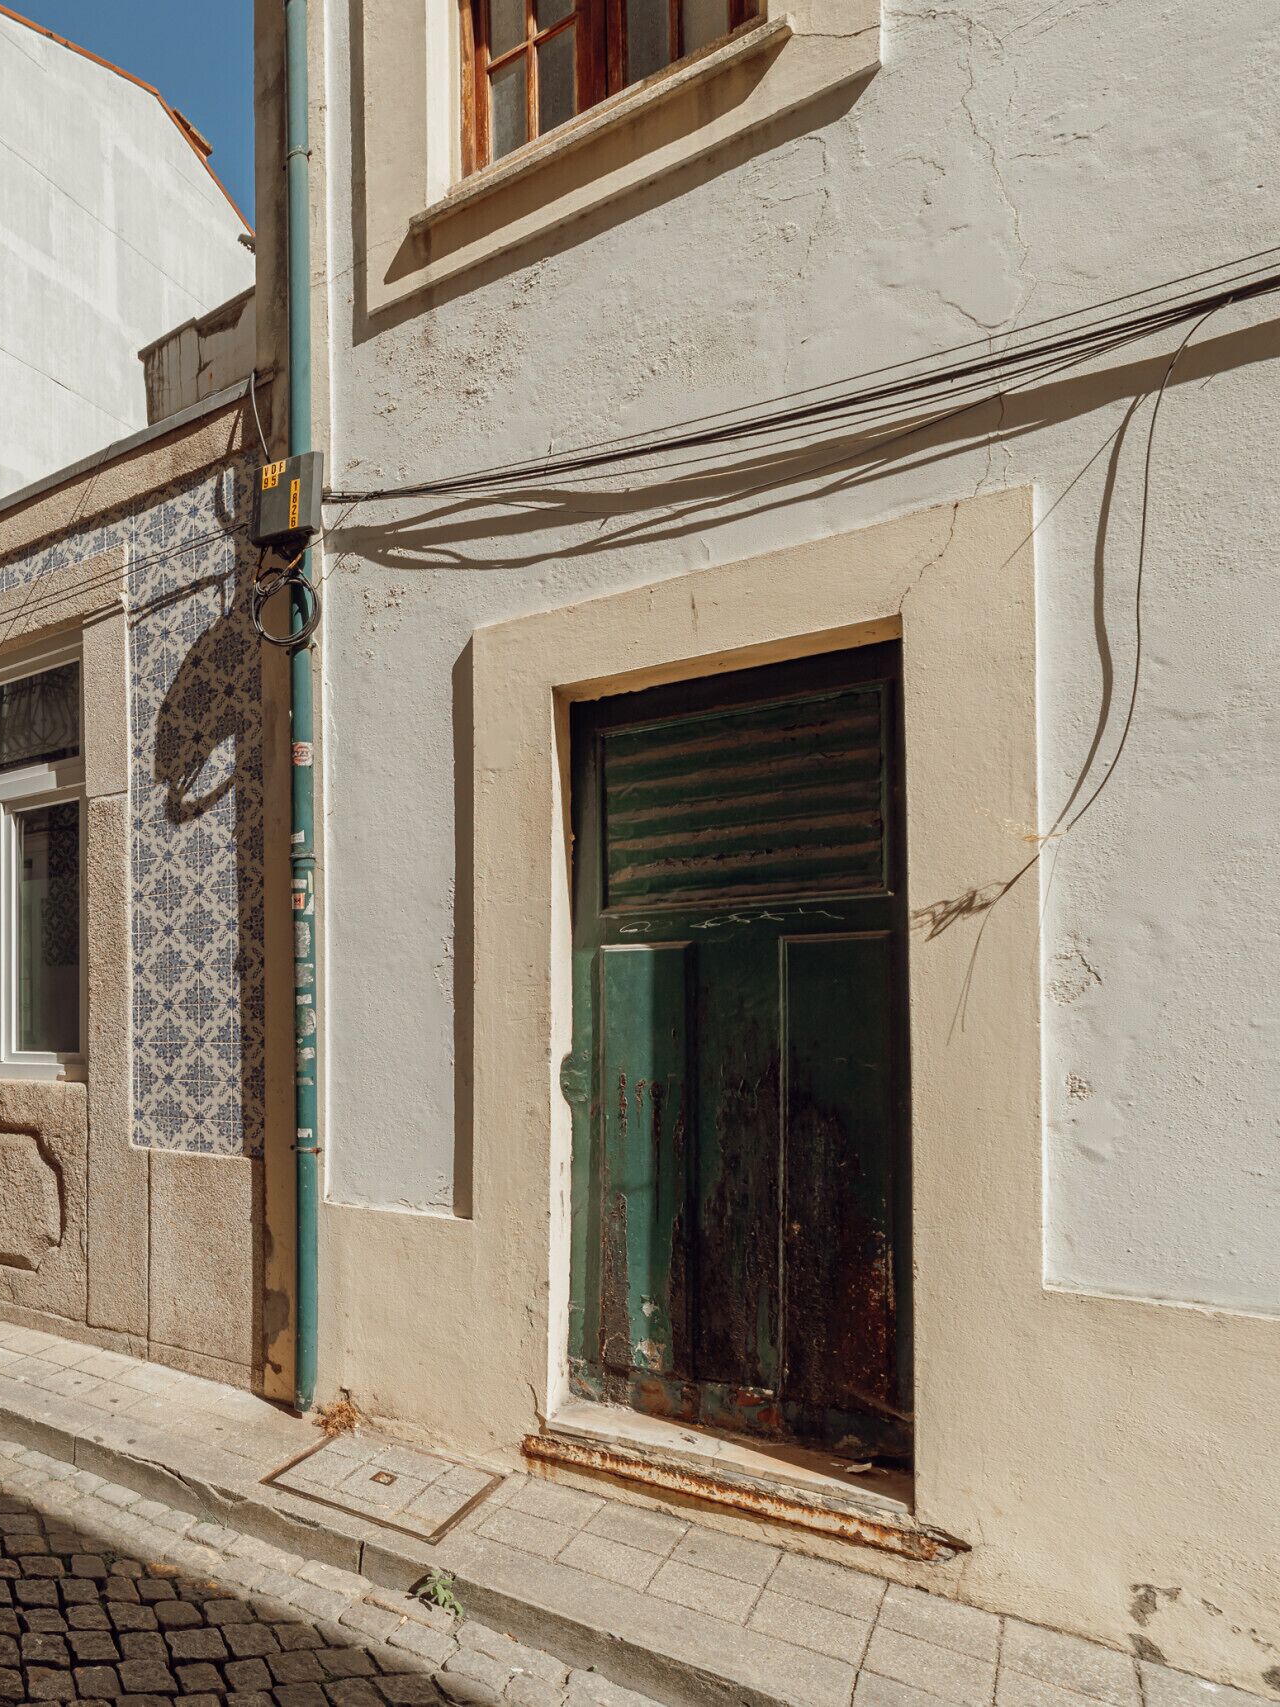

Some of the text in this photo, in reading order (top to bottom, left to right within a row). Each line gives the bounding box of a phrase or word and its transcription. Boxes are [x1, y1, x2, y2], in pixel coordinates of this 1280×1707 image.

[264, 461, 284, 477] VDF
[263, 475, 277, 489] 95
[290, 480, 298, 527] 1826
